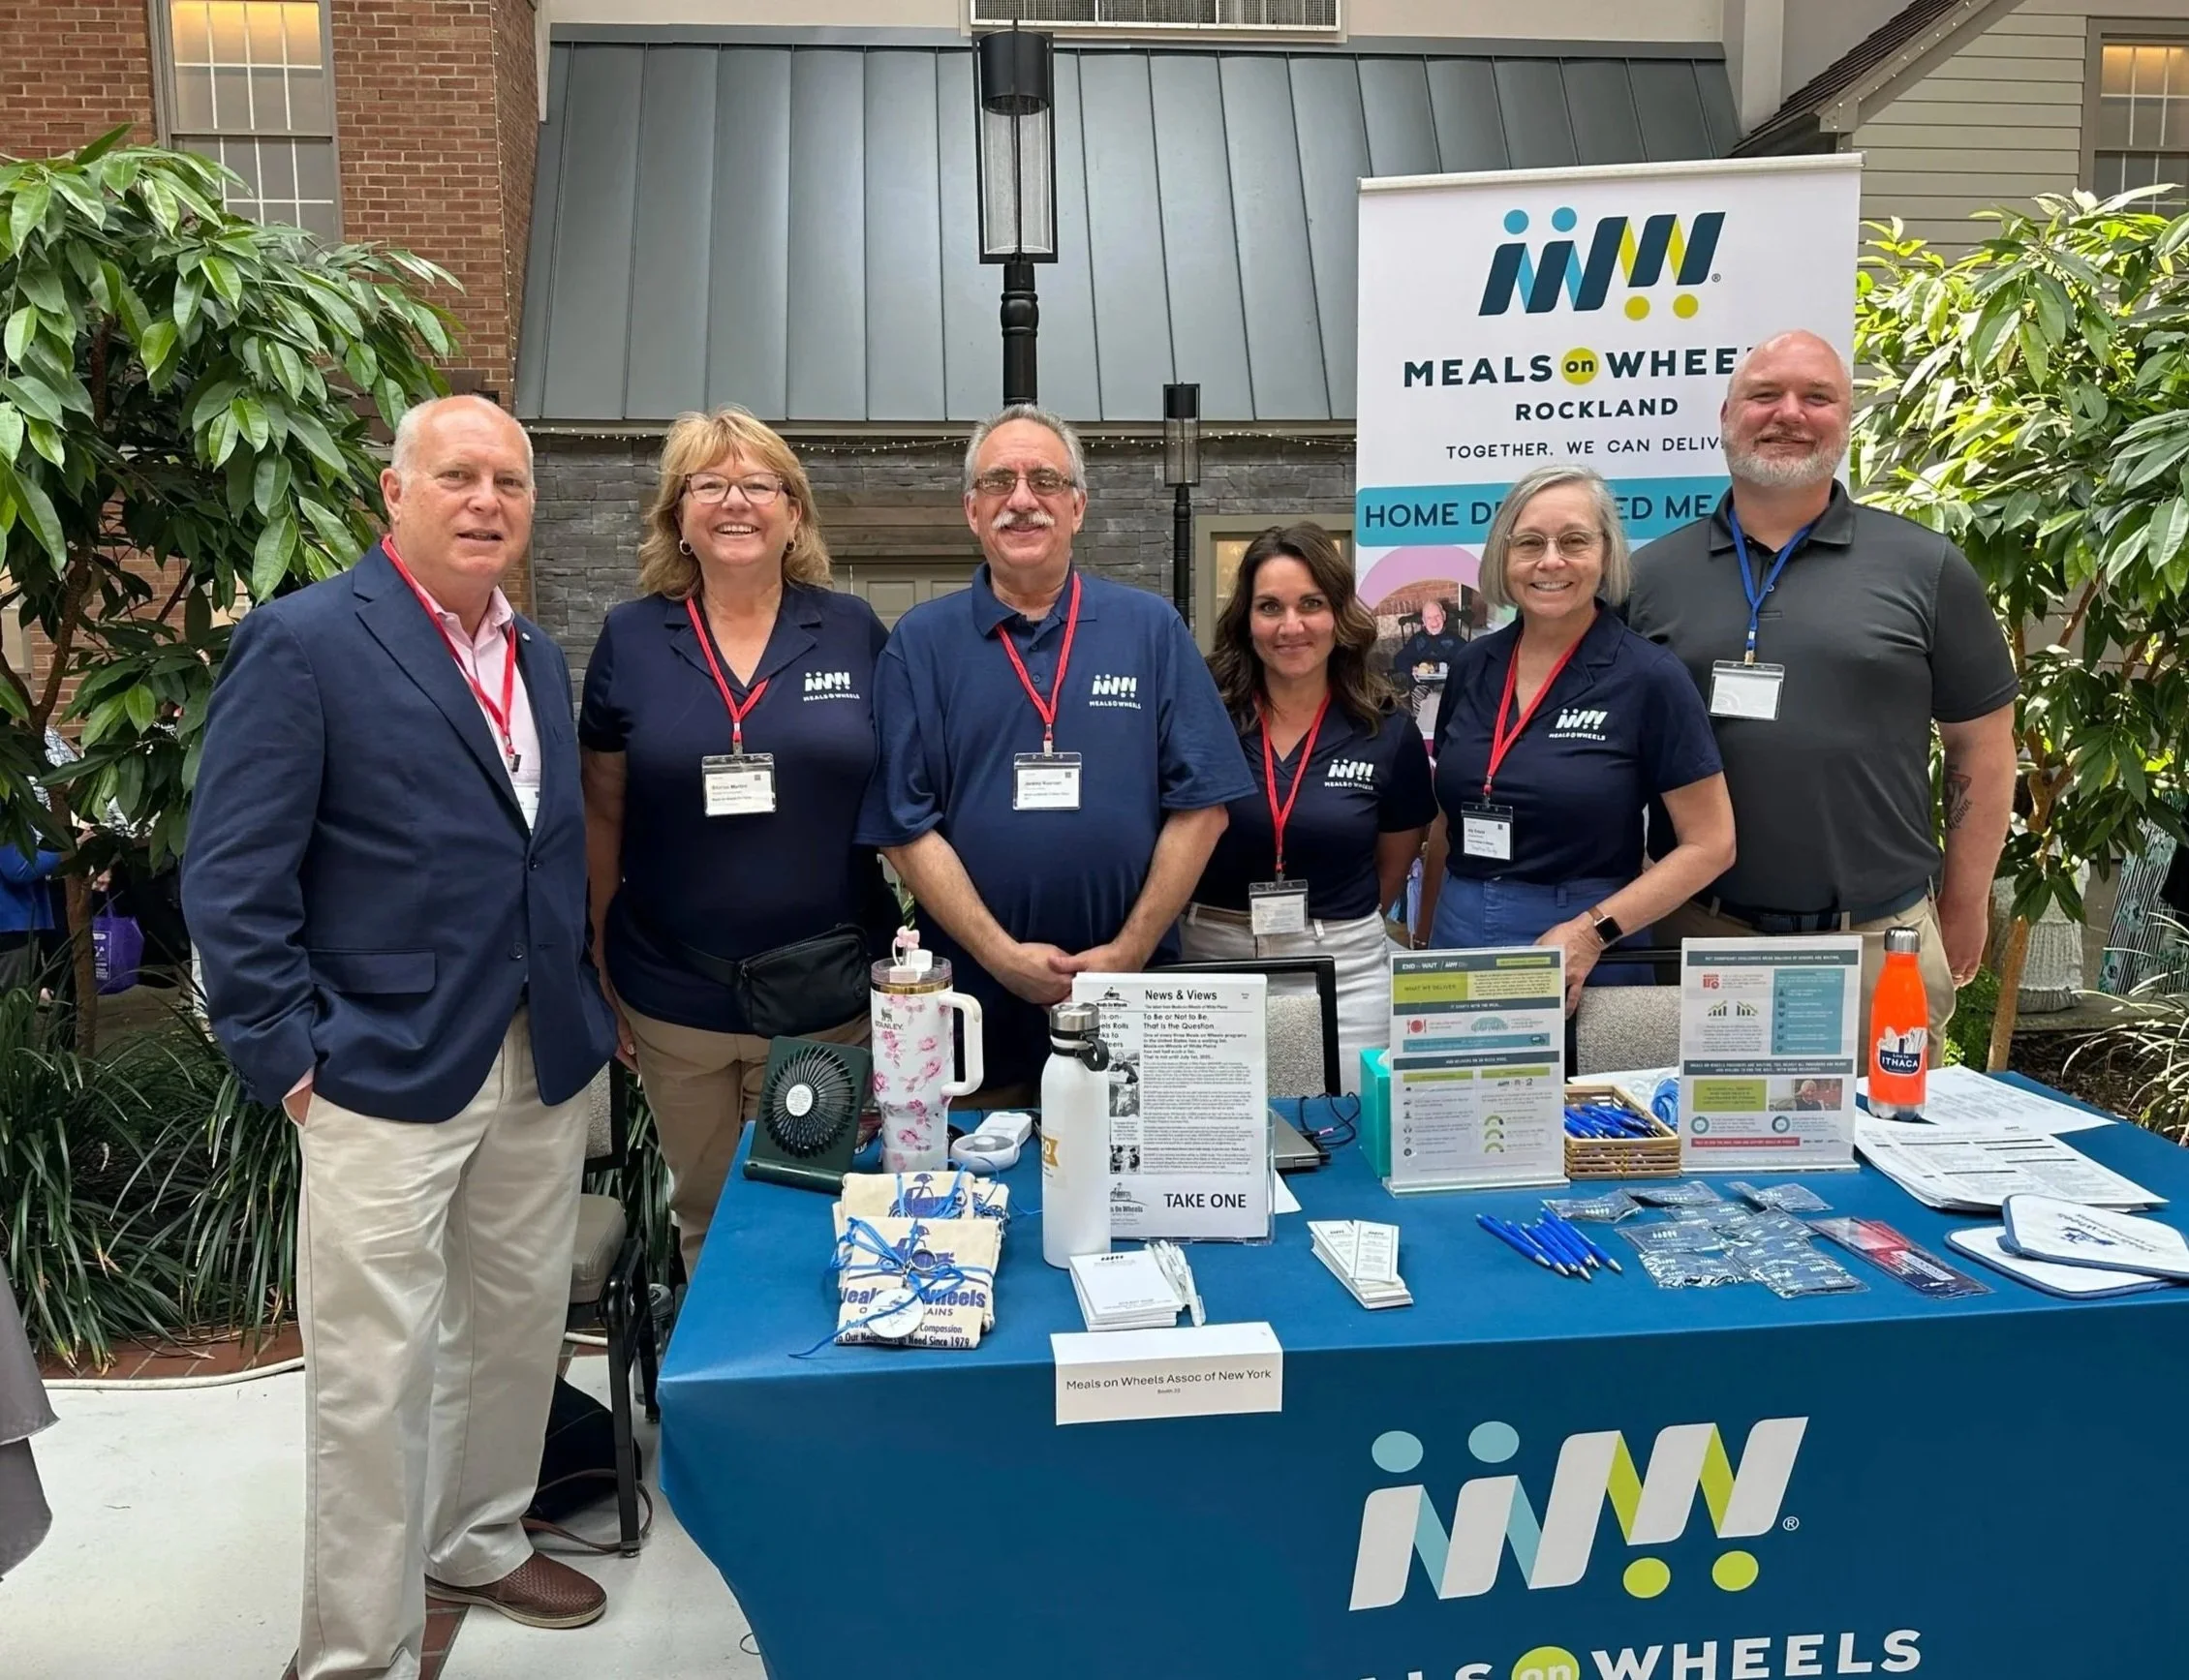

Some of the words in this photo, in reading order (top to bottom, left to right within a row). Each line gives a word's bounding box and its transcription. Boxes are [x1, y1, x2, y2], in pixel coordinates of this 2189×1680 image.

[1404, 353, 1552, 387] MEALS
[1565, 358, 1595, 375] on
[1606, 348, 1752, 379] WHEE
[1515, 398, 1679, 421] ROCKLAND
[1567, 441, 1594, 454] WE
[1607, 439, 1650, 453] CAN
[1662, 437, 1723, 451] DELIV
[1365, 503, 1459, 528] HOME
[1145, 990, 1173, 1000] News
[1176, 990, 1184, 1000] &
[1187, 989, 1218, 1000] Views
[1882, 1056, 1919, 1068] ITHACA
[1163, 1193, 1206, 1208] TAKE
[1210, 1193, 1247, 1208] ONE
[841, 1288, 883, 1304] eal
[919, 1322, 963, 1333] Compassion
[845, 1333, 859, 1342] Our
[909, 1333, 928, 1345] Need
[928, 1335, 948, 1346] Since
[950, 1337, 970, 1348] 1979
[1066, 1380, 1101, 1390] Meals
[1103, 1379, 1119, 1388] on
[1121, 1375, 1164, 1387] Wheels
[1166, 1372, 1202, 1384] Assoc
[1204, 1371, 1217, 1382] of
[1218, 1369, 1245, 1381] New
[1246, 1368, 1272, 1380] York
[1590, 1629, 1922, 1680] WHEELS
